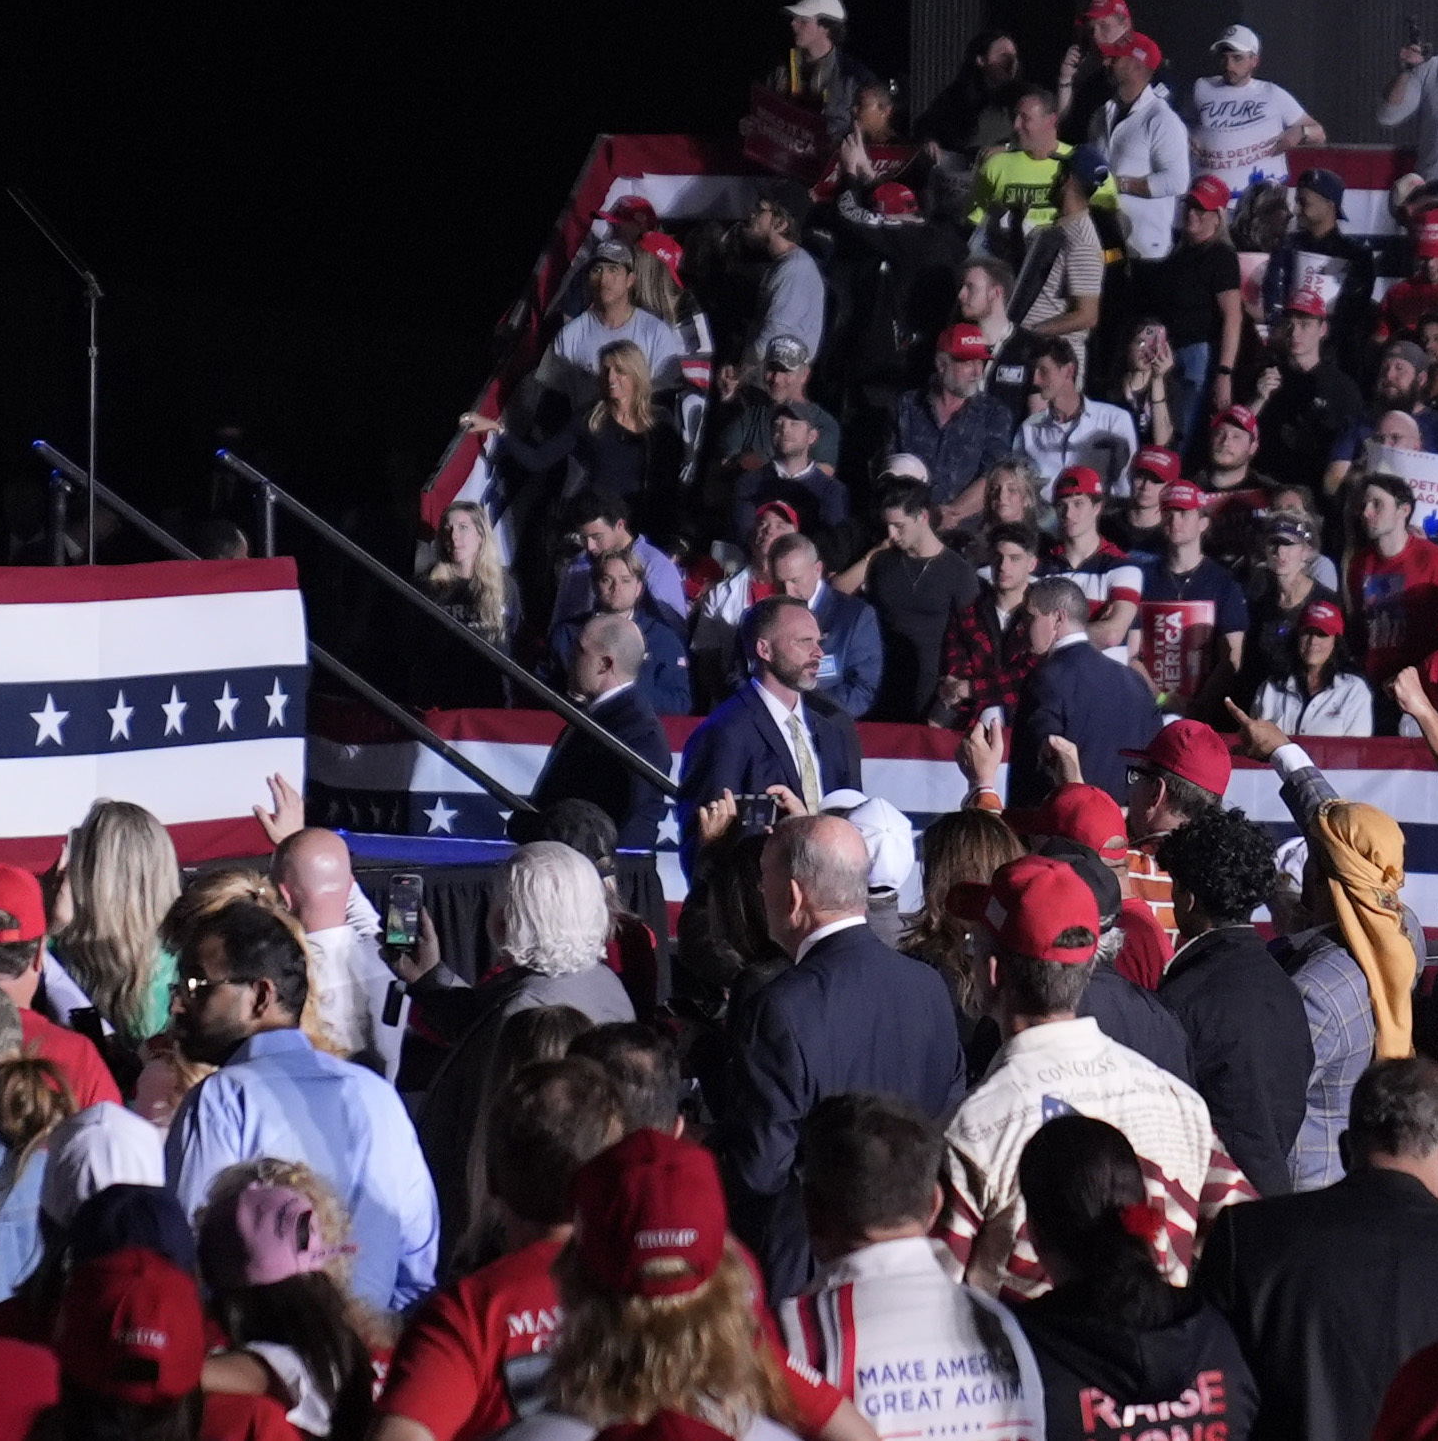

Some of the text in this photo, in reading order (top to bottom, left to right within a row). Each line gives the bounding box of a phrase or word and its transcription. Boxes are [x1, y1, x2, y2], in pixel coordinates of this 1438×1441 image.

[1201, 100, 1267, 118] FUTURE
[1037, 1056, 1118, 1084] CONGRESS
[857, 1360, 927, 1389] MAKE
[864, 1388, 942, 1416] GREAT
